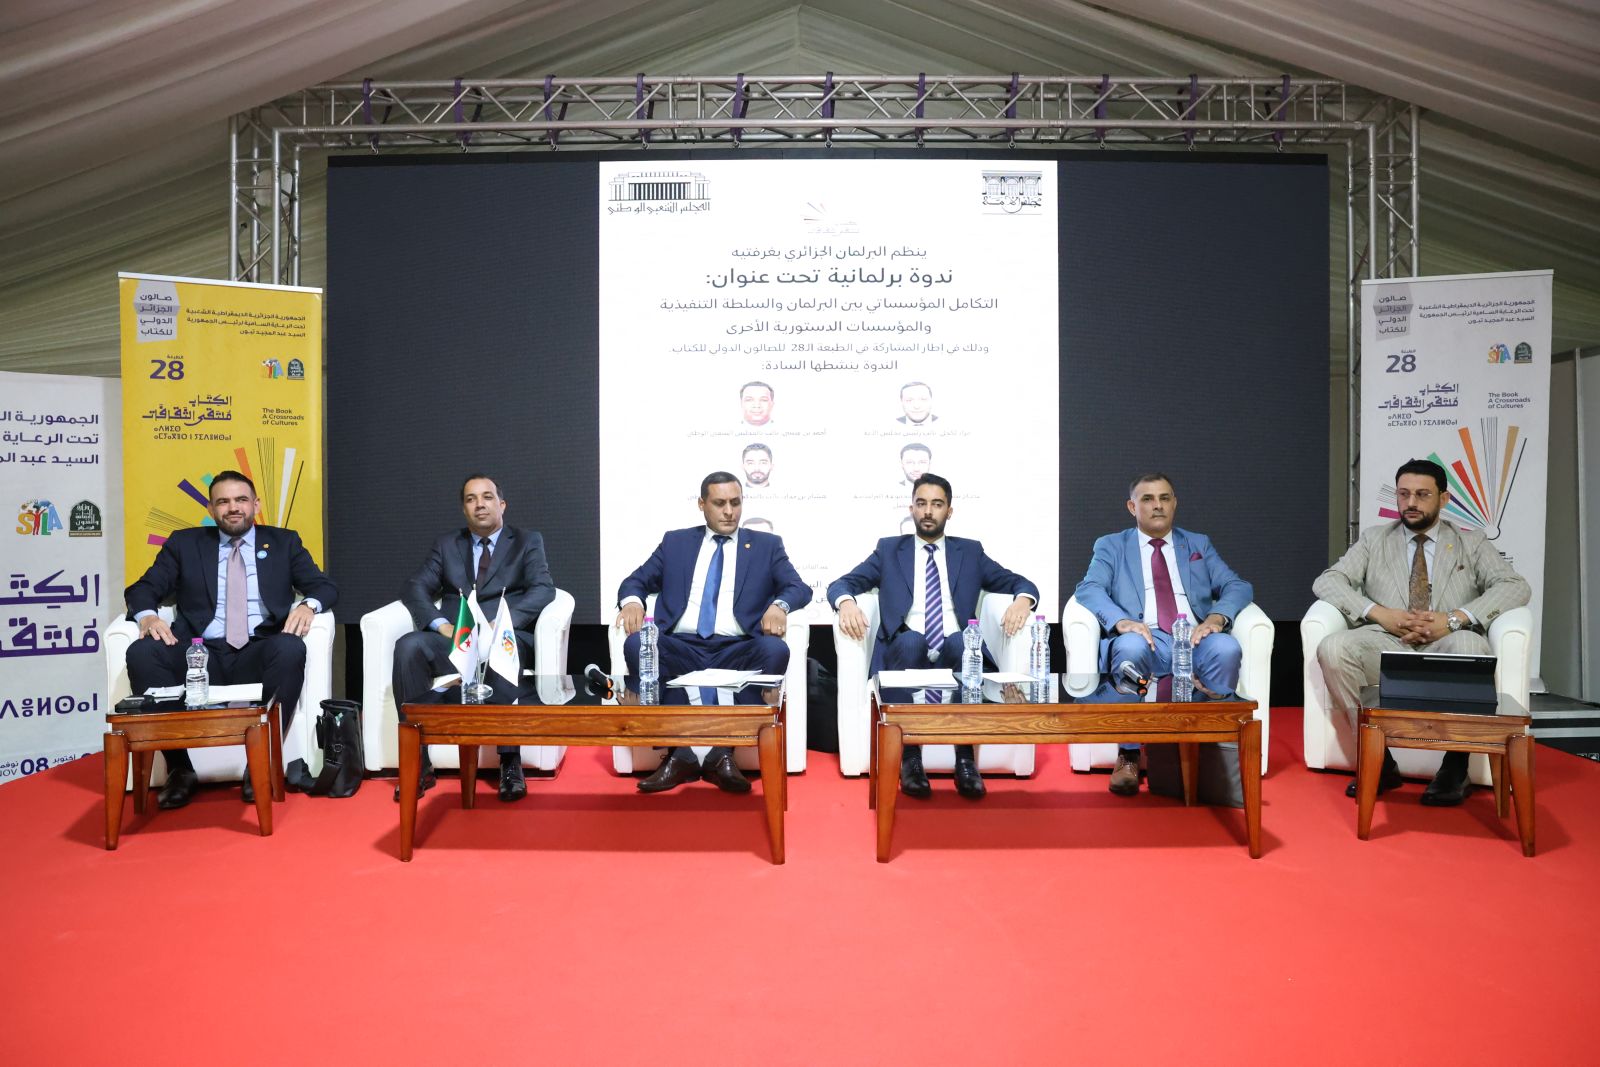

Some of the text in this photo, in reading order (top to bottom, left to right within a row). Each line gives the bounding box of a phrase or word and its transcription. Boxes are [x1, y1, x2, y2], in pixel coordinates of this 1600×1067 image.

[731, 246, 927, 262] ينظم البرلمان الجزائري بغرفتيه
[706, 267, 953, 289] ندوة برلمانية تحت عنوان:
[140, 293, 173, 302] صالون
[1378, 295, 1407, 304] صالون
[140, 303, 173, 314] الجزائر
[659, 297, 998, 314] التكامل المؤسساتي بين البرلمان والسلطة التنفيذية
[140, 316, 173, 326] الدولي
[726, 319, 932, 335] والمؤسسات الدستورية الأخرى
[1378, 315, 1407, 326] الدولي
[140, 327, 173, 337] للكتاب
[1378, 326, 1407, 335] للكتاب
[962, 343, 989, 354] وذلك
[149, 358, 185, 381] 28
[761, 360, 898, 373] الندوة ينشطها السادة:
[1385, 353, 1417, 374] 28
[15, 410, 99, 427] الجمهورية
[268, 413, 305, 421] Crossroads
[2, 430, 99, 446] تحت الرعاية
[19, 454, 47, 467] عبد
[51, 454, 99, 467] السيد
[20, 757, 50, 776] 08
